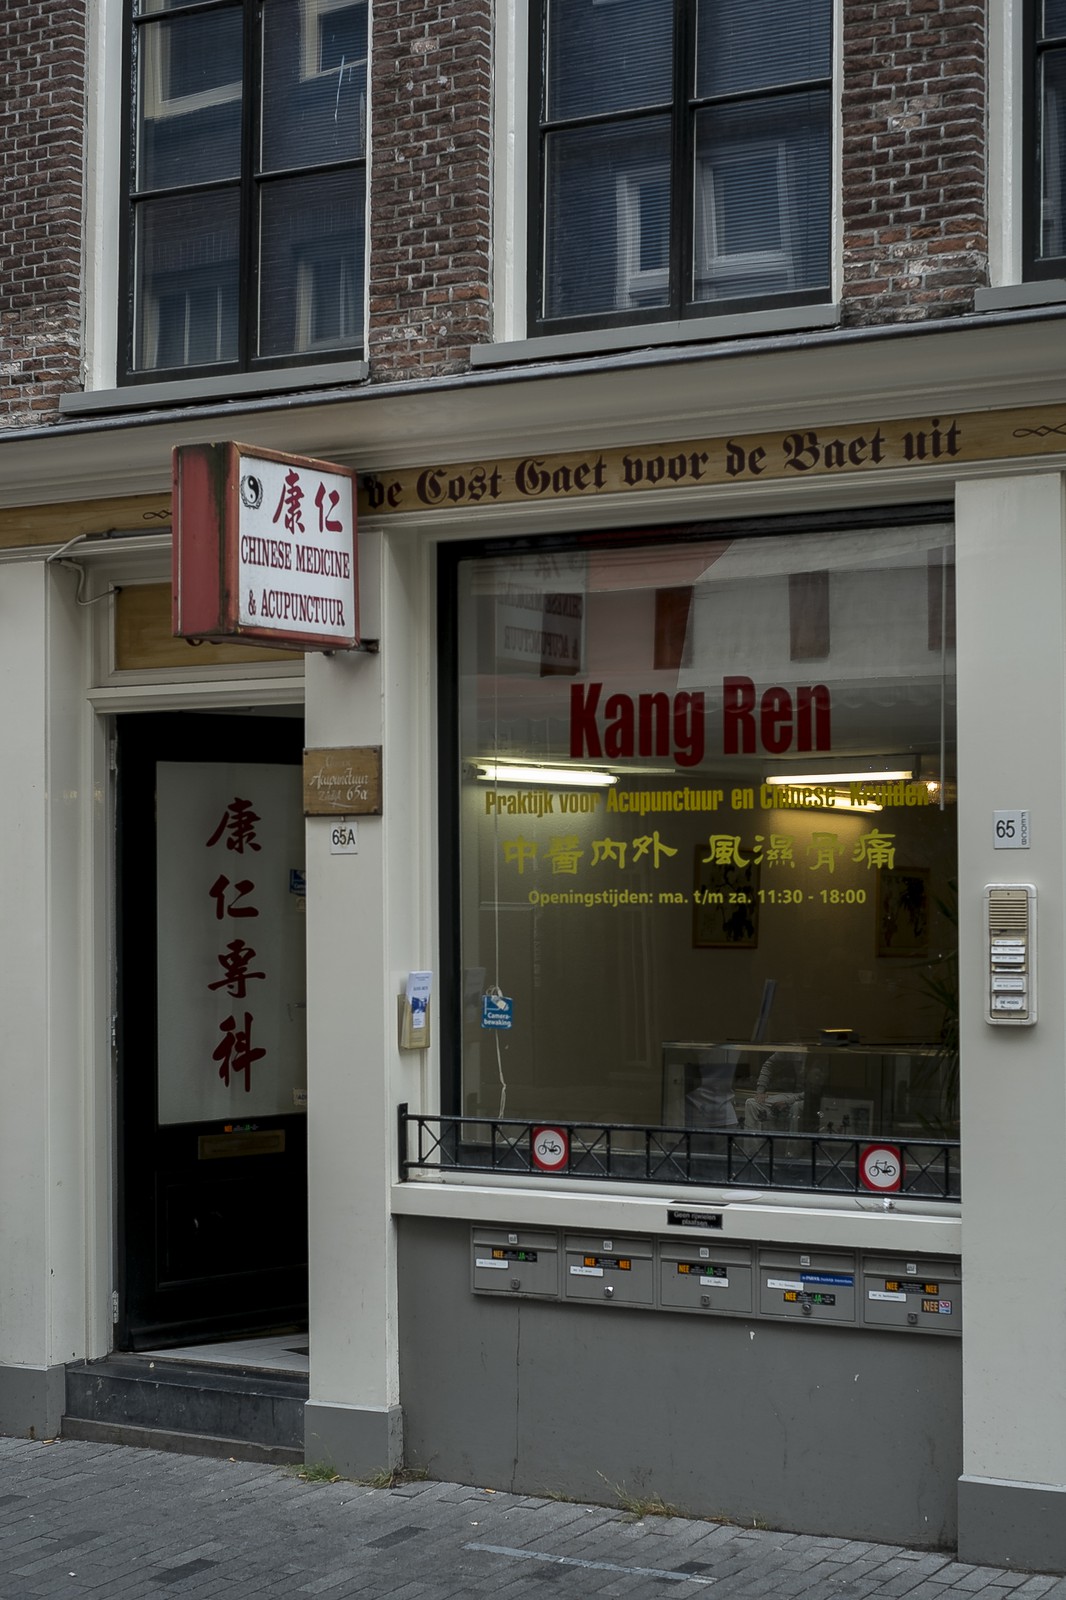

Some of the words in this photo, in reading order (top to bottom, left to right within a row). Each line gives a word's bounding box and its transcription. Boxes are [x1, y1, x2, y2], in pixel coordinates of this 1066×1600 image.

[416, 463, 504, 506] Cost
[514, 454, 607, 496] Gaet
[622, 444, 710, 487] voor
[725, 438, 767, 479] de
[784, 426, 886, 472] Baet
[901, 418, 963, 461] uit
[273, 467, 343, 535] 康仁
[241, 534, 292, 571] CHINESE
[296, 543, 350, 579] MEDICINE
[248, 589, 257, 616] &
[261, 589, 345, 627] ACUPUNCTUUR
[570, 682, 706, 767] Kang
[723, 675, 831, 755] Ren
[485, 789, 554, 818] Praktijk
[559, 791, 601, 813] voor
[606, 786, 723, 817] Acupunctuur
[732, 788, 755, 809] en
[760, 782, 836, 809] Chinese
[849, 781, 930, 807] Kruiden
[332, 829, 356, 845] 65A
[996, 820, 1015, 838] 65
[528, 888, 654, 907] Openingstijden:
[658, 892, 689, 905] ma.
[693, 889, 724, 905] t/m
[728, 891, 752, 905] za.
[757, 889, 803, 905] 11:30
[819, 889, 867, 905] 18:00
[483, 1019, 512, 1028] bewaking
[493, 1249, 504, 1259] NEE
[785, 1291, 797, 1301] NEE
[886, 1282, 899, 1291] NEE
[925, 1285, 938, 1294] NEE
[923, 1301, 939, 1312] NEE
